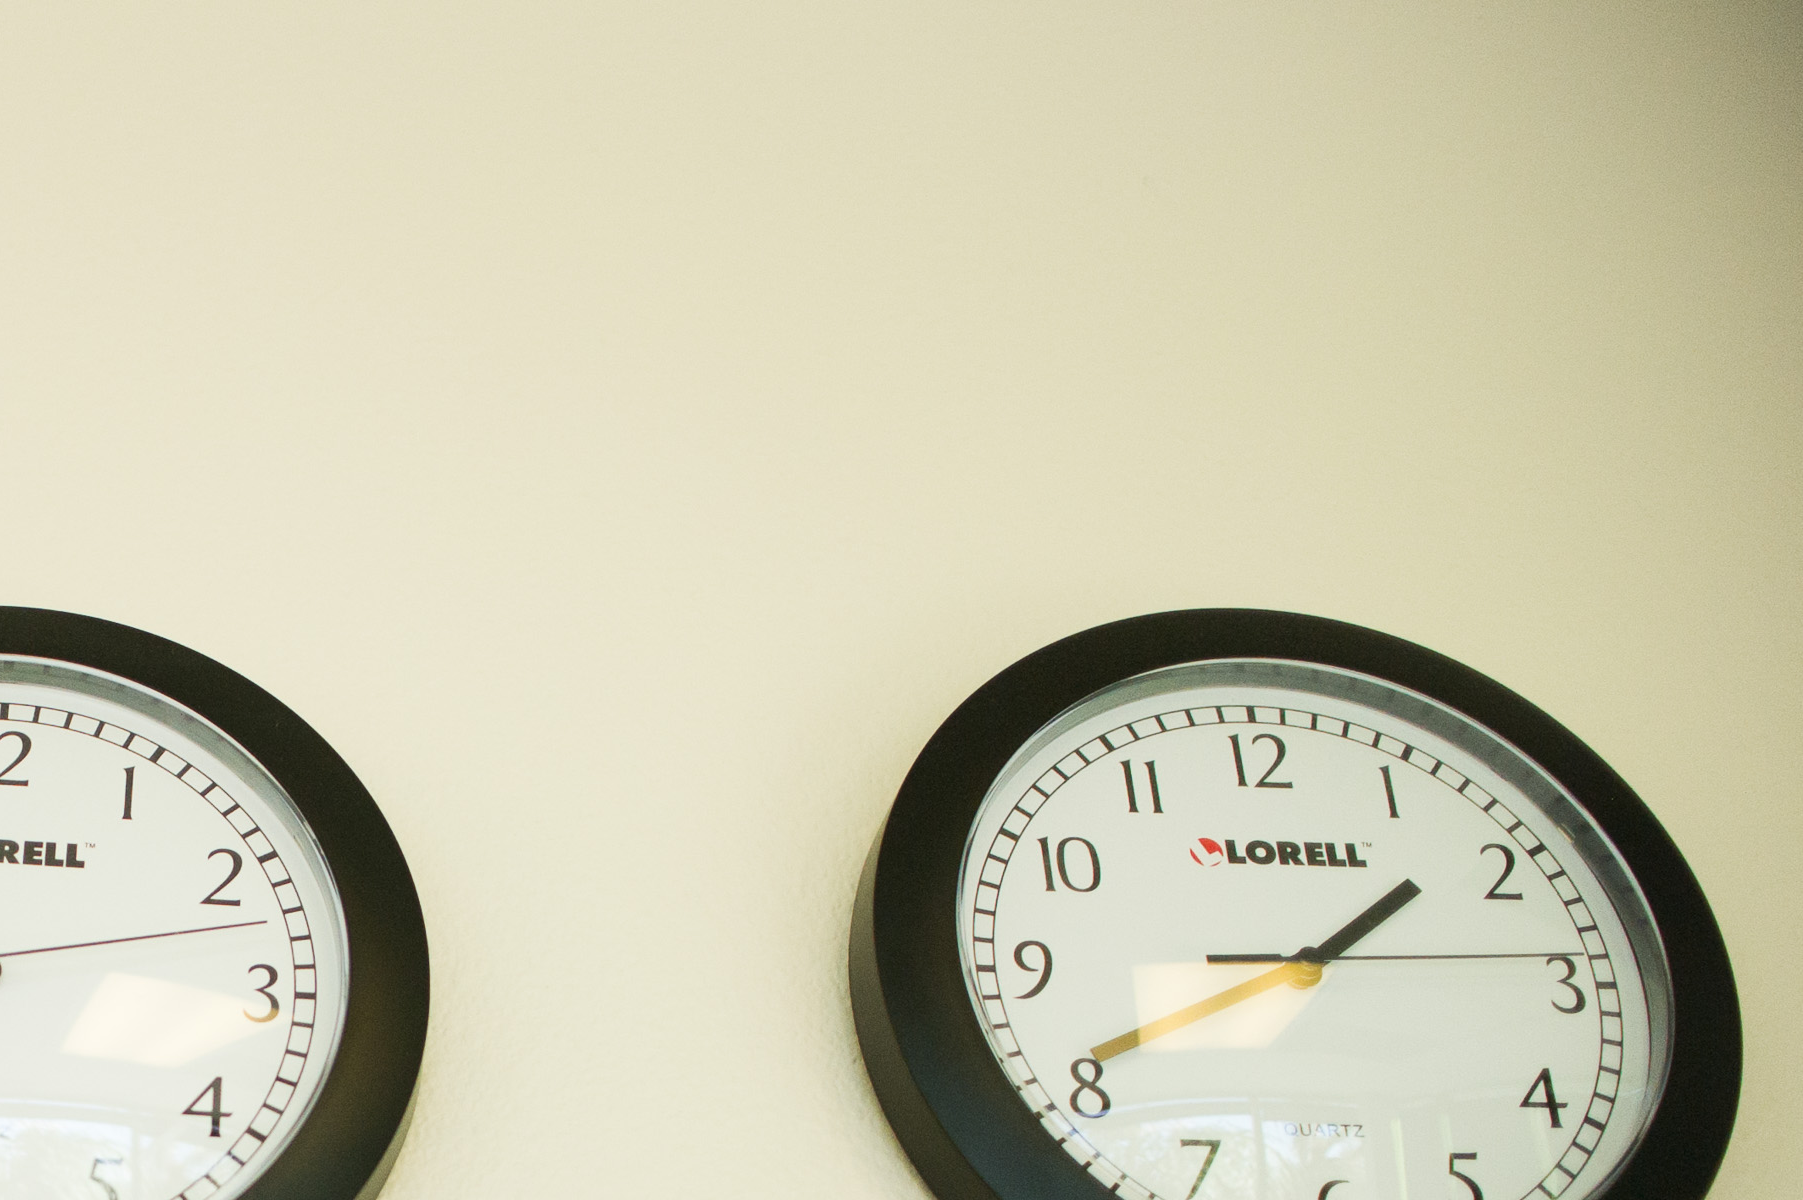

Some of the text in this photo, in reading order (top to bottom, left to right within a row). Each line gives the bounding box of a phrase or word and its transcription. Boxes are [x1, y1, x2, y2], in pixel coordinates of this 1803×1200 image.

[1120, 759, 1164, 814] 11
[1228, 733, 1294, 789] 12
[121, 766, 137, 820] 1
[1379, 765, 1401, 818] 1
[199, 848, 244, 907] 2
[1037, 836, 1102, 892] 10
[1225, 840, 1367, 868] LORELL
[1480, 843, 1524, 900] 2
[242, 963, 280, 1023] 3
[1013, 940, 1053, 999] 9
[1544, 955, 1587, 1014] 3
[182, 1076, 234, 1137] 4
[1069, 1057, 1112, 1118] 8
[1519, 1068, 1569, 1128] 4
[1283, 1122, 1365, 1138] QUARTZ
[1179, 1138, 1222, 1200] 7
